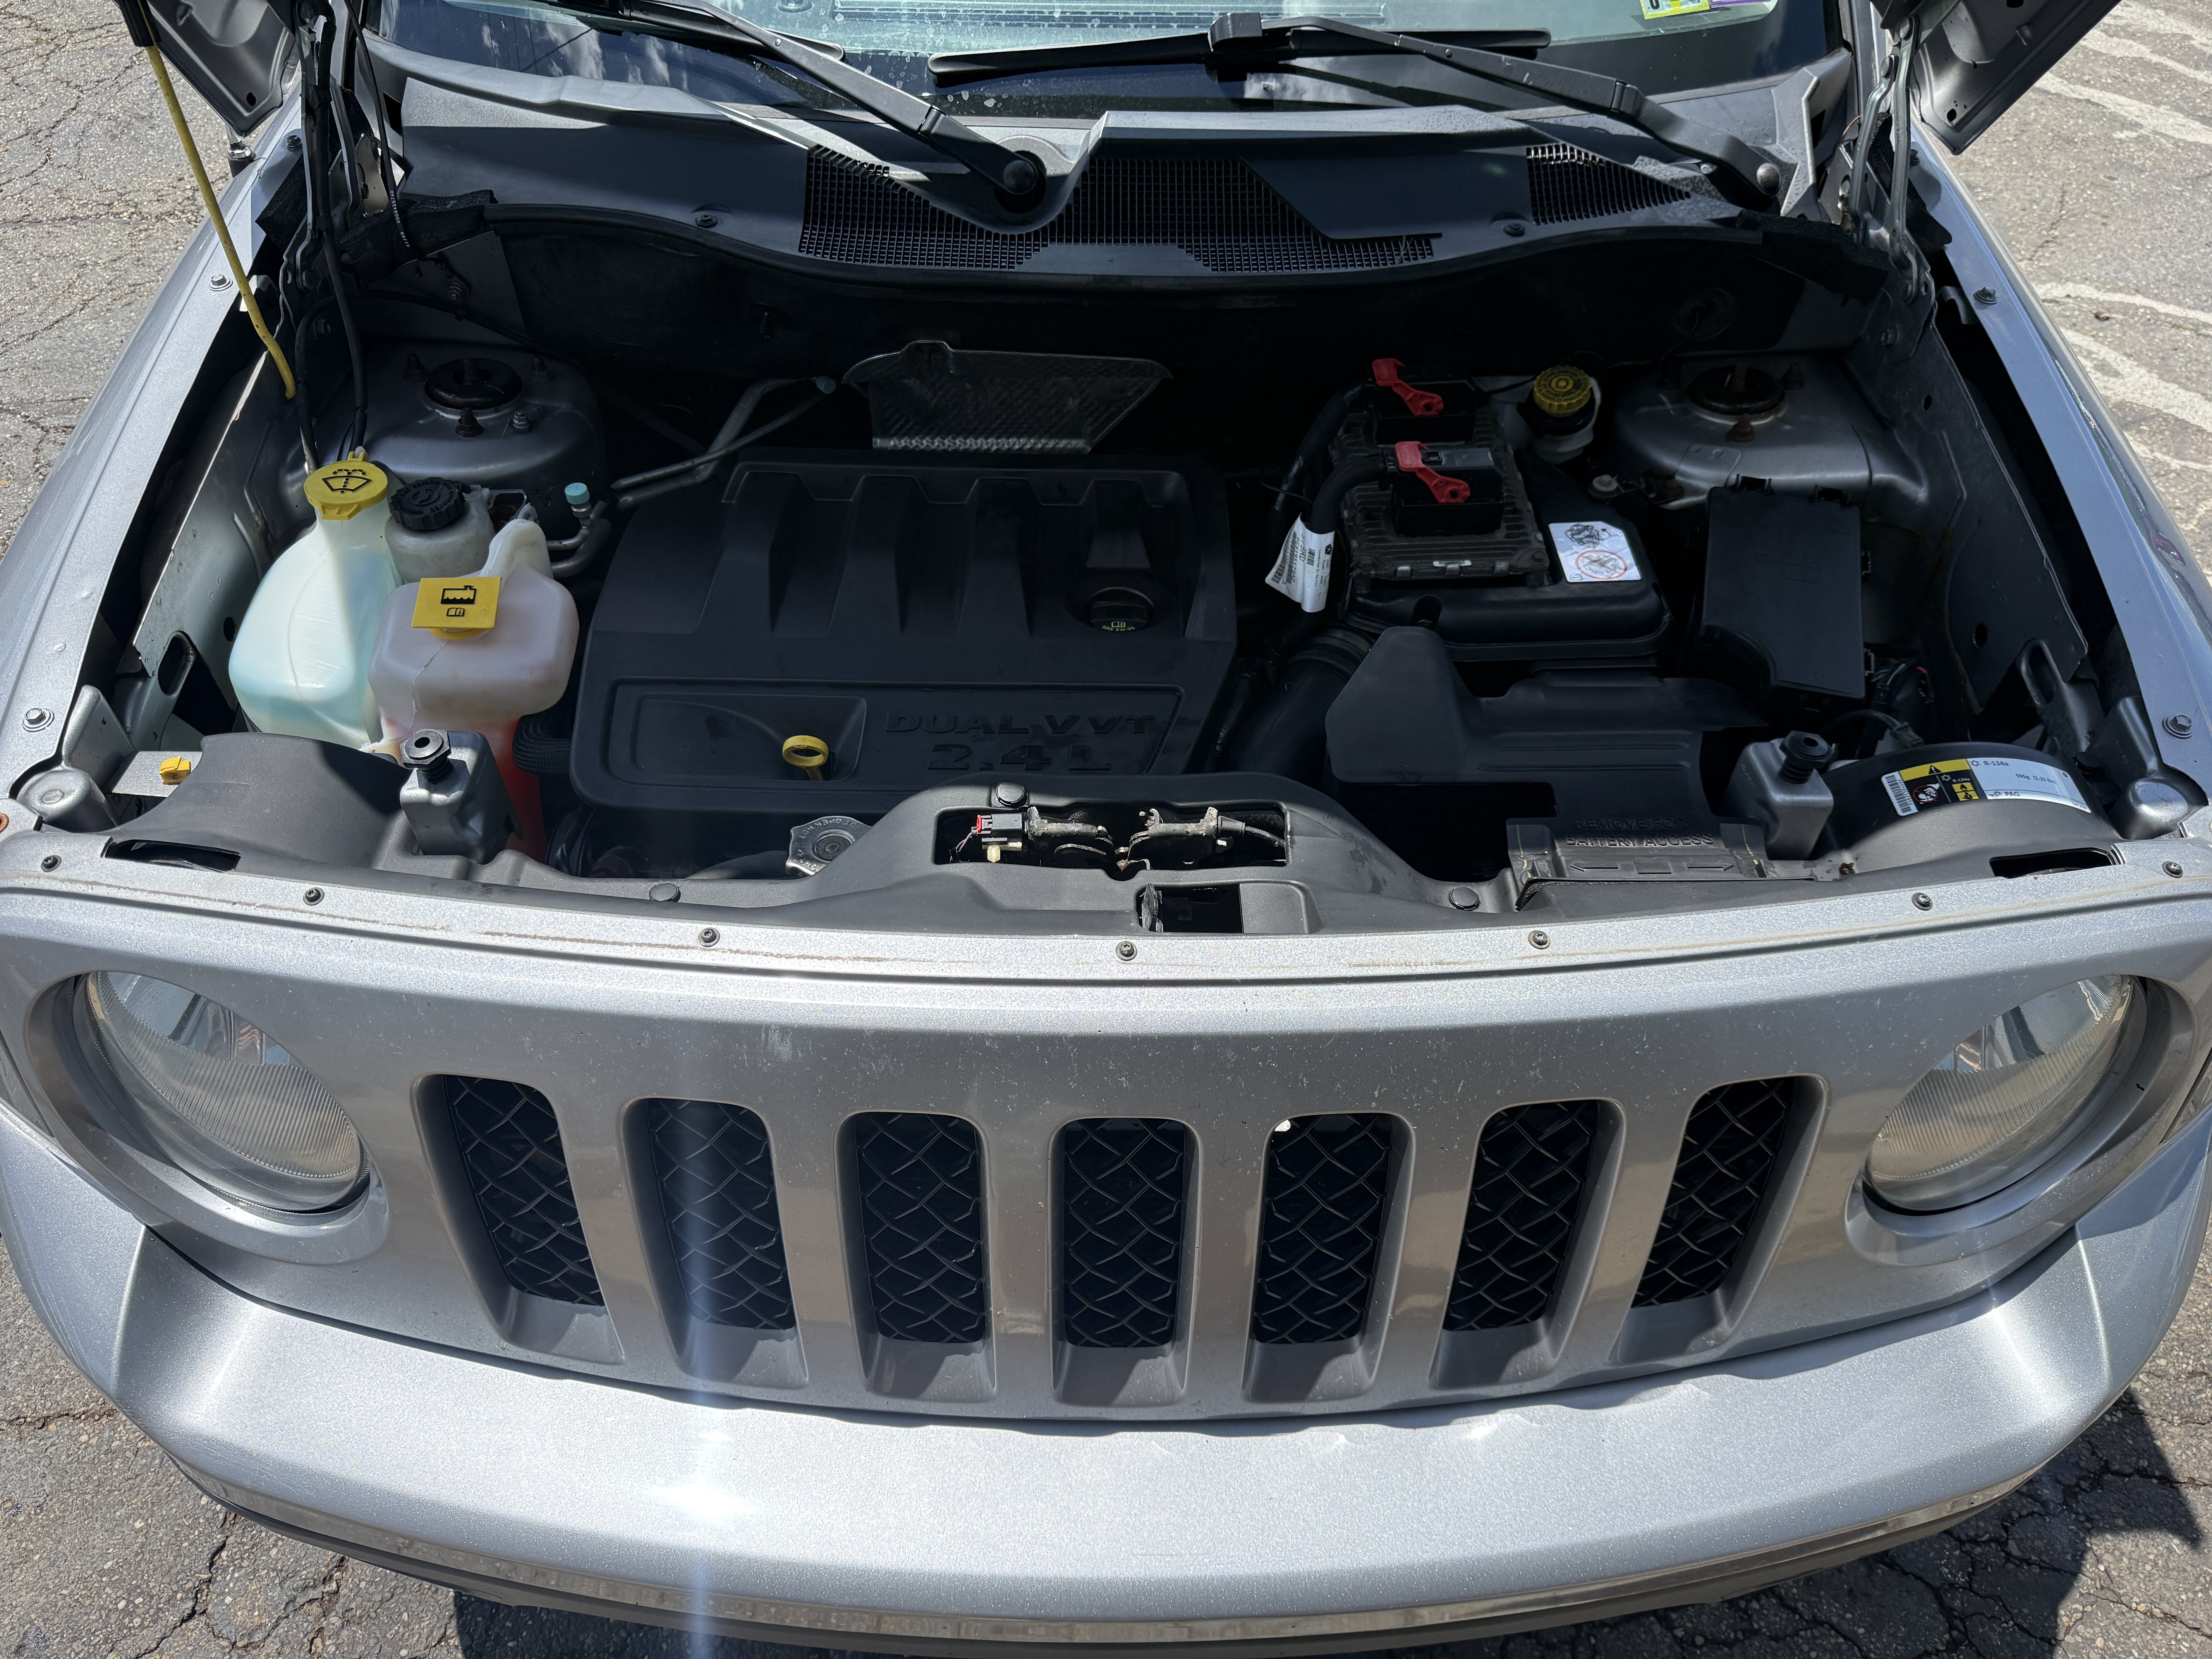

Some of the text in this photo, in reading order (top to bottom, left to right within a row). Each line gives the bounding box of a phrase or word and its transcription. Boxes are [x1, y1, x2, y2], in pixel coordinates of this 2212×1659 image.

[886, 714, 1155, 734] DUAL VVT
[927, 744, 1111, 771] 2.4L
[1576, 817, 1688, 830] REMOVE FOR
[1565, 833, 1714, 847] BATTERY ACCESS
